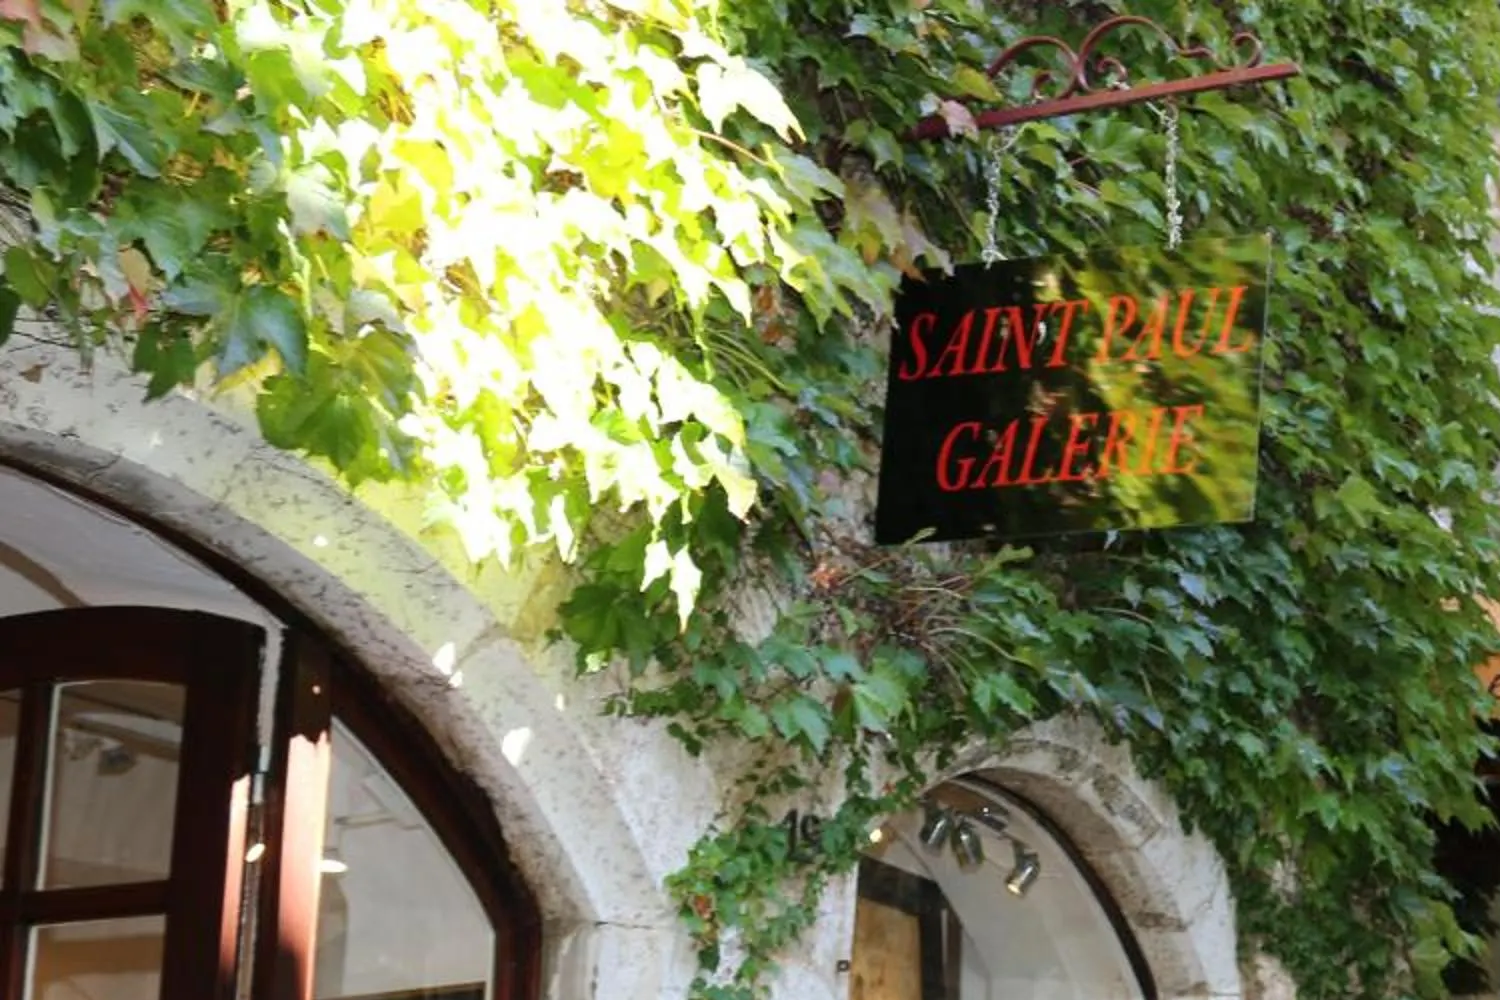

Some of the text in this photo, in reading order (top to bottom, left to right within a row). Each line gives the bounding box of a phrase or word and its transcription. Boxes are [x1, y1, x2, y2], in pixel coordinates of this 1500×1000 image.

[900, 285, 1255, 381] SAINT PAUL
[935, 403, 1205, 492] GALERIE
